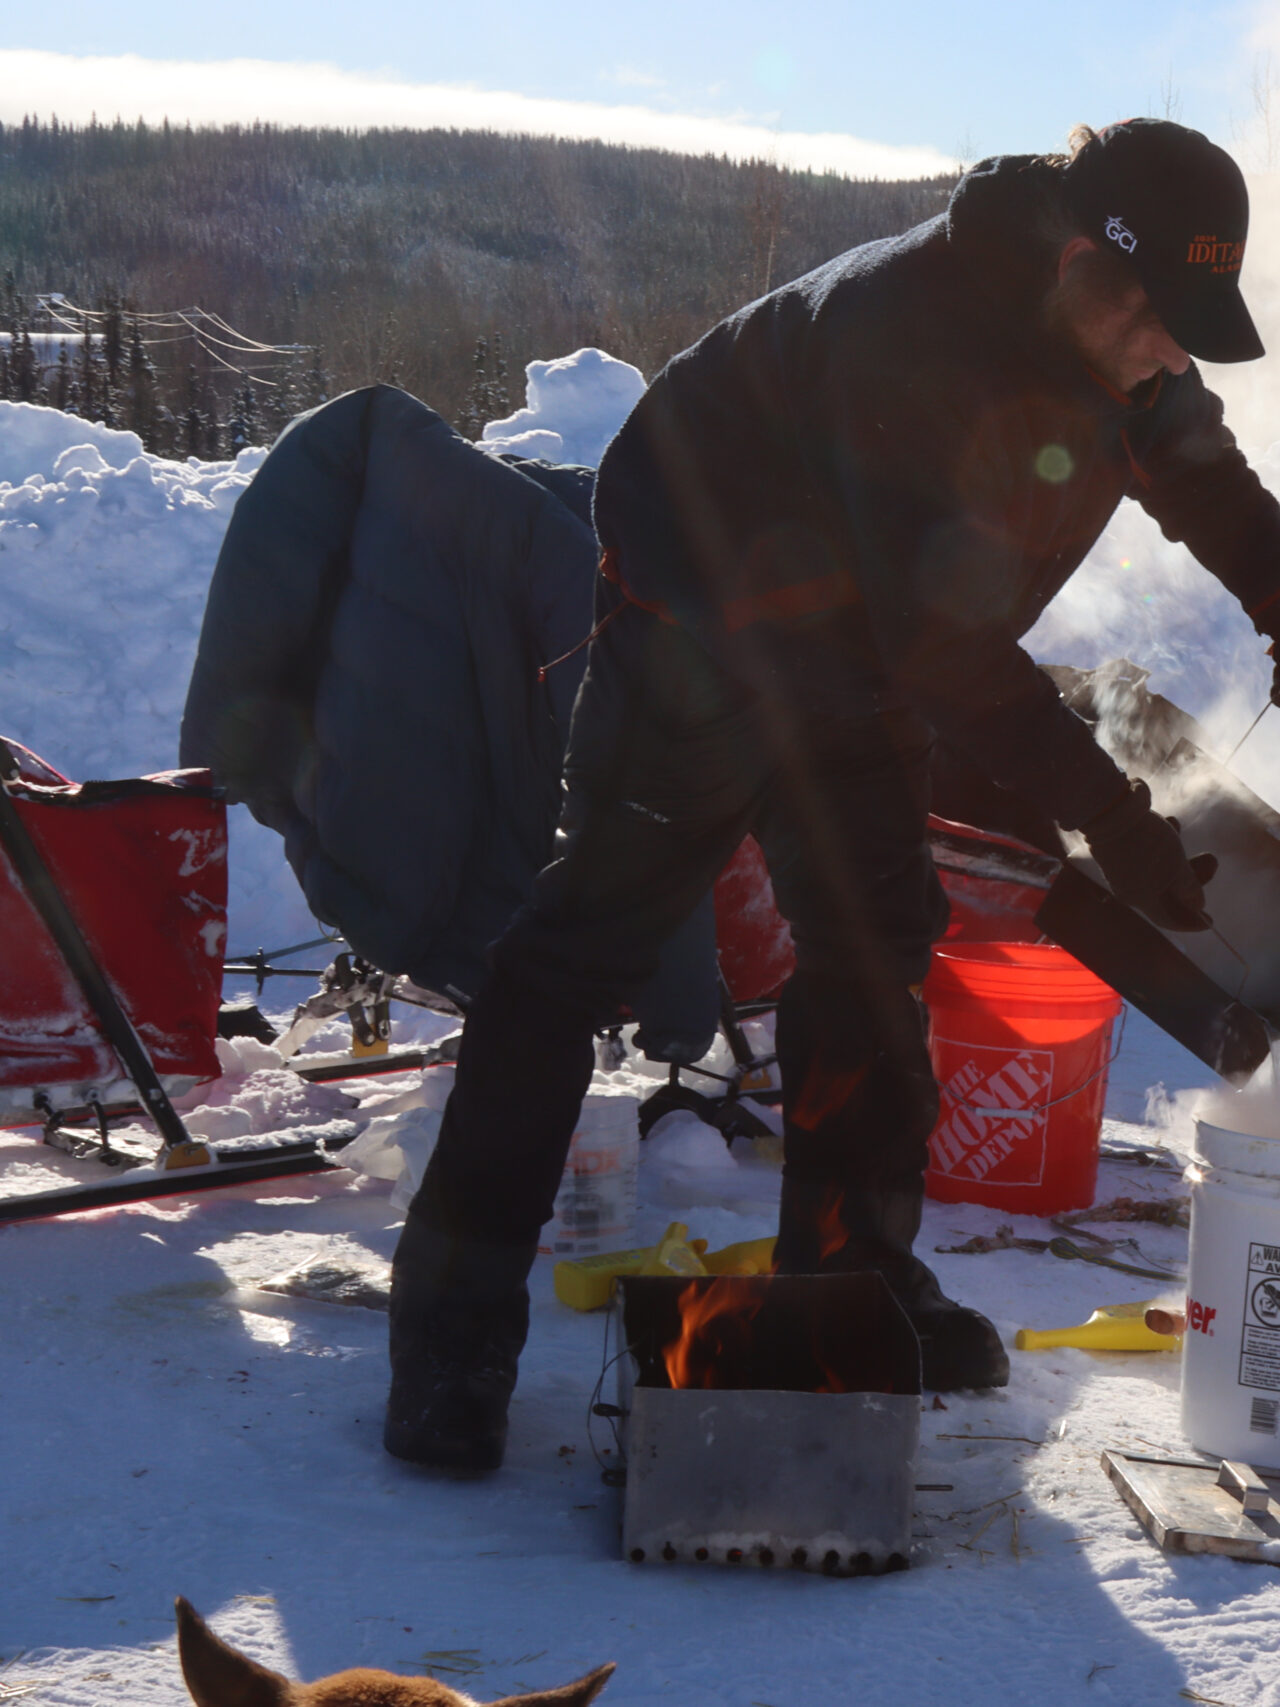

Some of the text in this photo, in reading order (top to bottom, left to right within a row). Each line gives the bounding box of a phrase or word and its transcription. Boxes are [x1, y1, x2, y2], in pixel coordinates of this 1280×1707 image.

[1105, 222, 1138, 254] GCI
[930, 1051, 1051, 1174] HOME
[941, 1060, 985, 1109] THE
[965, 1102, 1045, 1181] DEPOT
